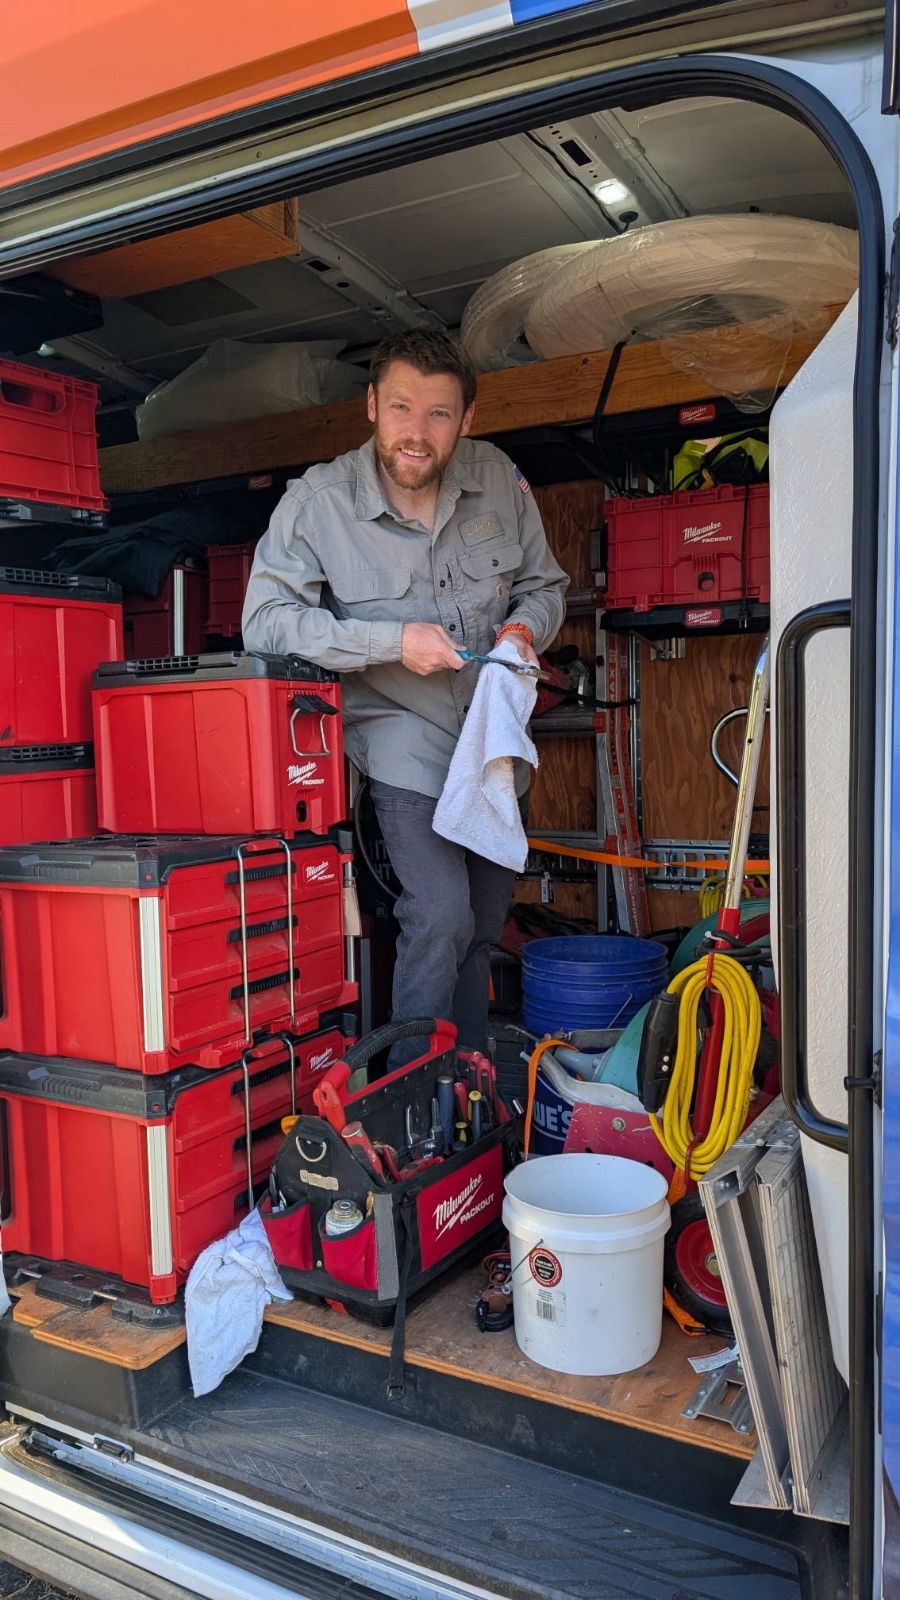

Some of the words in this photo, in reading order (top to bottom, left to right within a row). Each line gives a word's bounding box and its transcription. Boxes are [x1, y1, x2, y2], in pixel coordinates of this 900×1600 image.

[682, 522, 721, 541] Milwaukee
[701, 535, 733, 544] PACKOUT
[286, 761, 317, 781] Milwaukee
[305, 861, 329, 880] Milwaukee
[310, 1048, 333, 1070] Milwaukee
[431, 1173, 483, 1231] Milwaukee
[459, 1193, 496, 1226] PACKOUT
